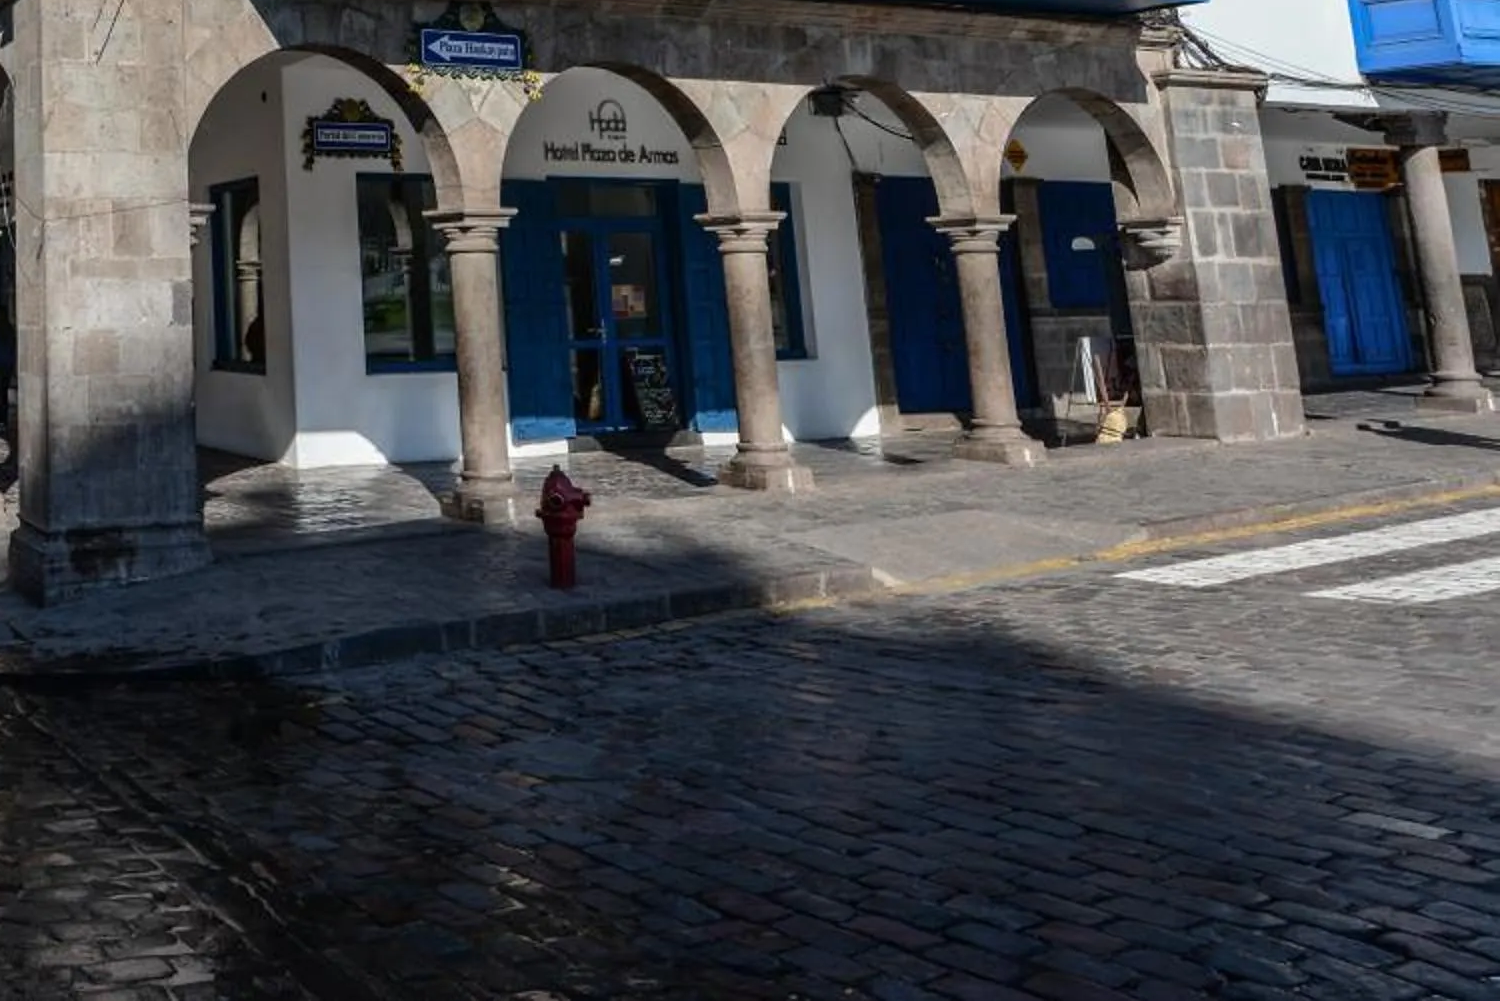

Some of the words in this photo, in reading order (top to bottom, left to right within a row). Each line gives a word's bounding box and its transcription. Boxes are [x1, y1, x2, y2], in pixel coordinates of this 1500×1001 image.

[543, 141, 579, 160] Hotel
[581, 142, 617, 161] Plaza
[618, 143, 635, 162] de
[639, 145, 679, 164] Armas
